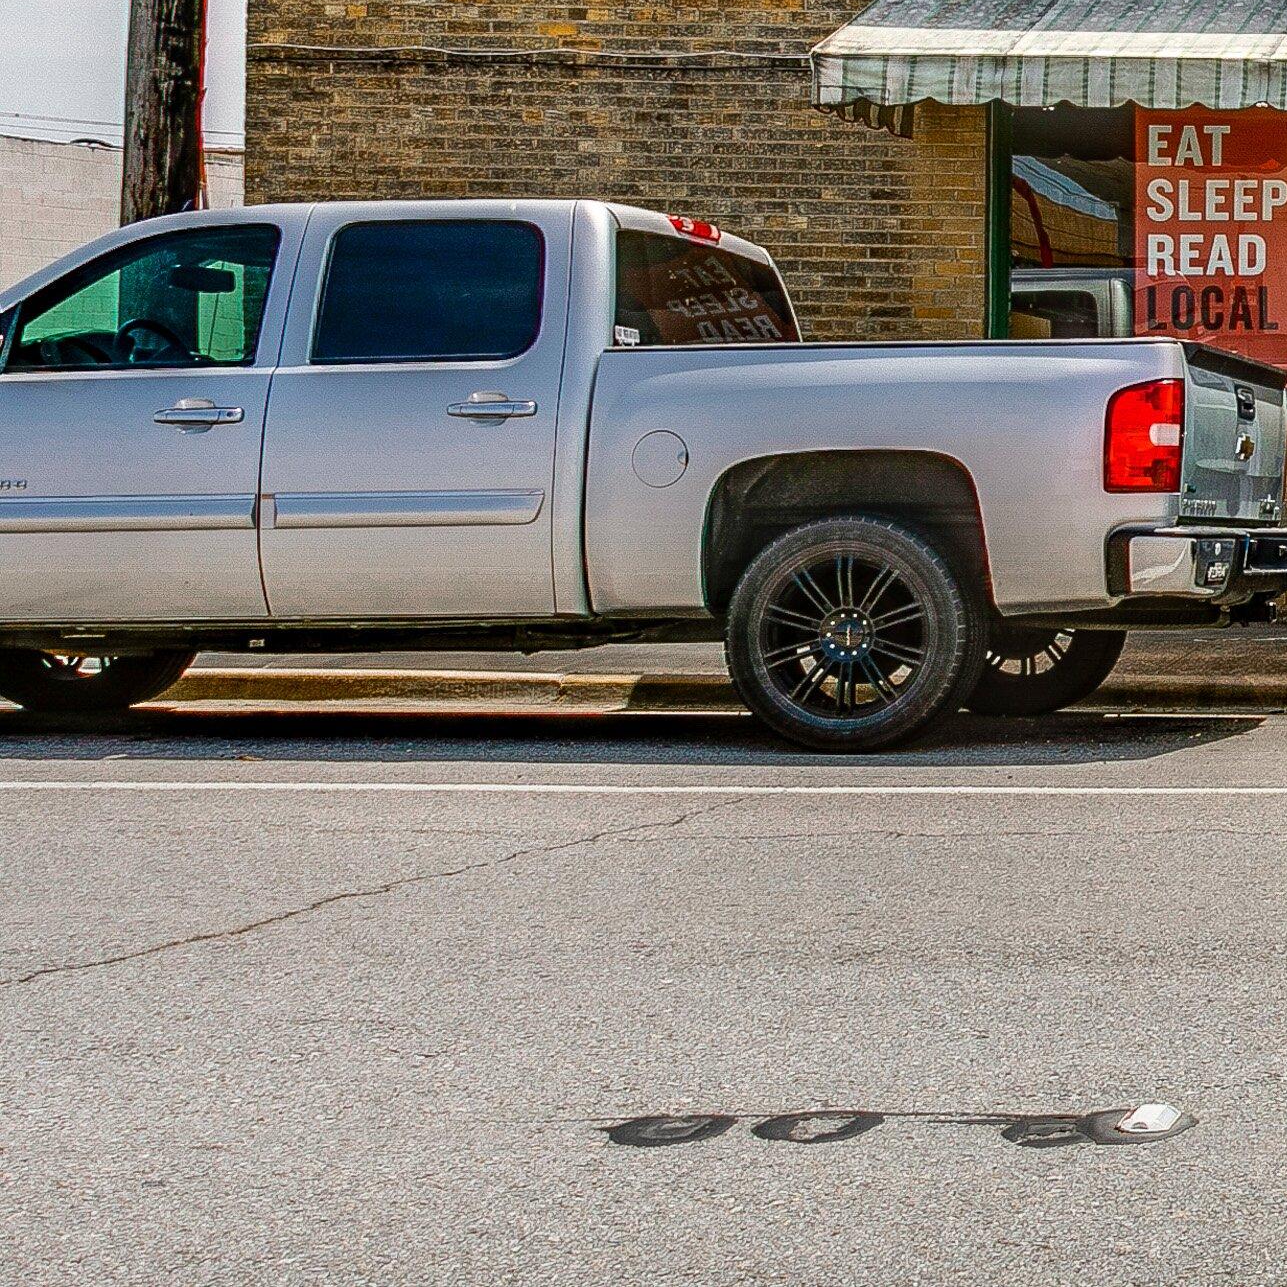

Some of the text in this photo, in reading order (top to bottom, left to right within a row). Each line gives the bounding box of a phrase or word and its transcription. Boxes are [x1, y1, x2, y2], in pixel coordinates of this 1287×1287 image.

[1148, 125, 1230, 167] EAT
[1147, 234, 1268, 277] READ
[1147, 285, 1279, 331] LOCAL
